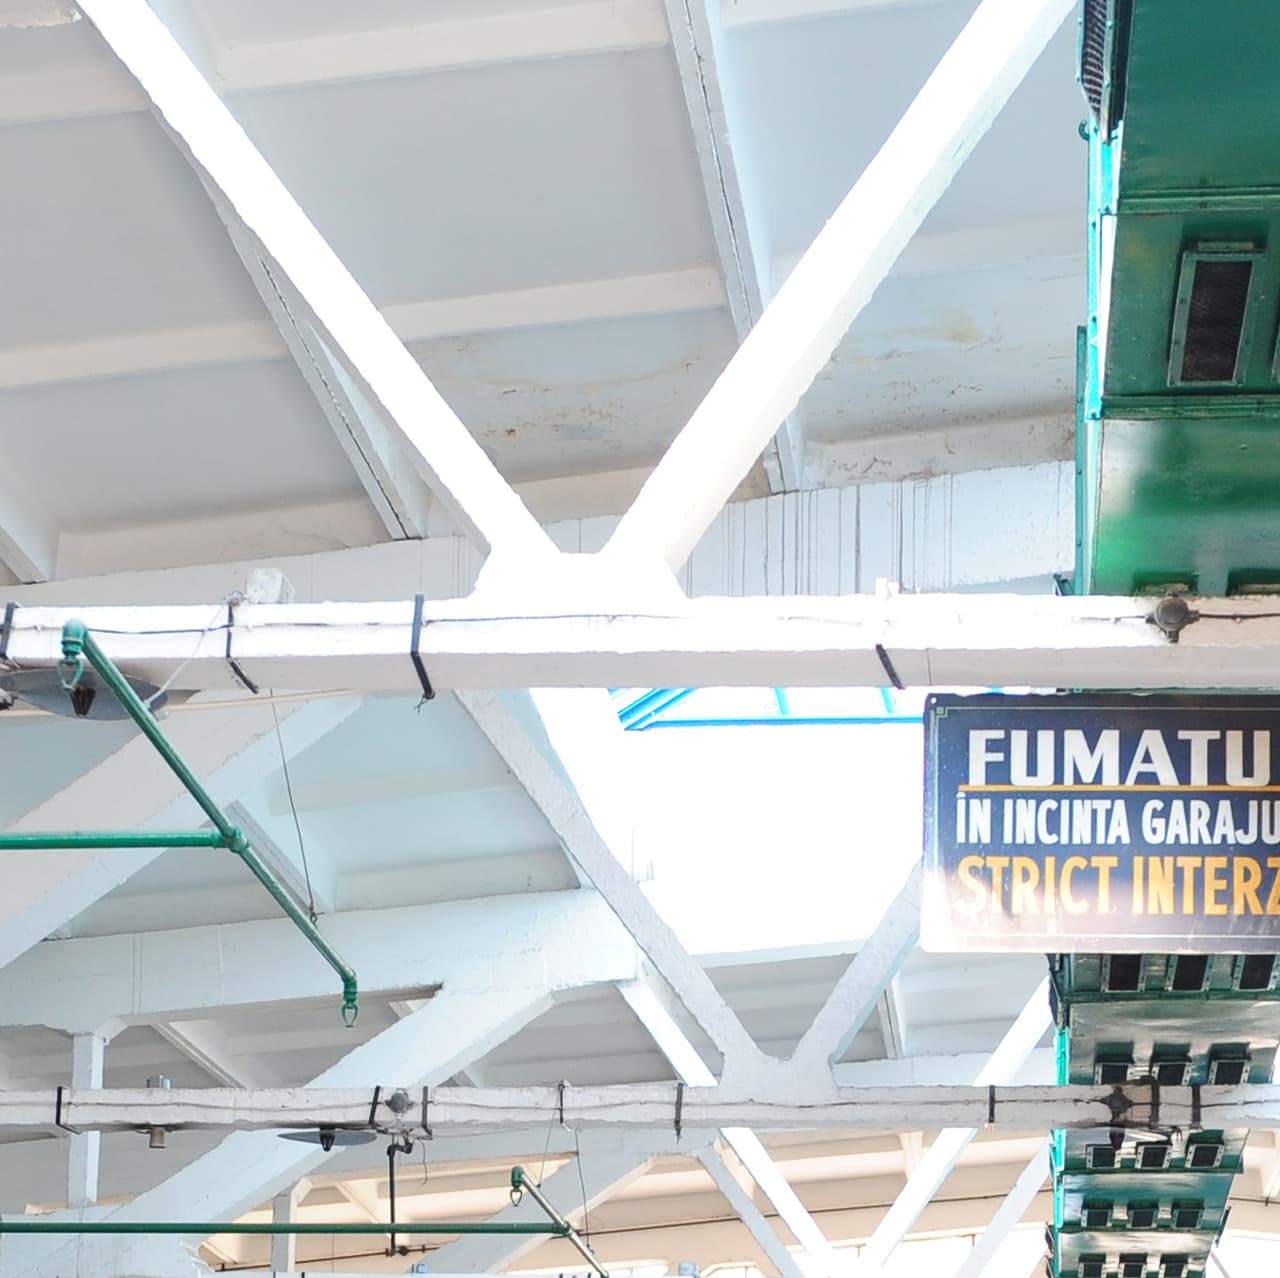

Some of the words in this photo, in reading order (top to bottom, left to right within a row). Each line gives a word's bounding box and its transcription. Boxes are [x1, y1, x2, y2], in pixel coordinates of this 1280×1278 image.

[956, 791, 992, 845] ÎN
[1003, 798, 1131, 845] INCINTA
[957, 855, 1118, 917] STRICT
